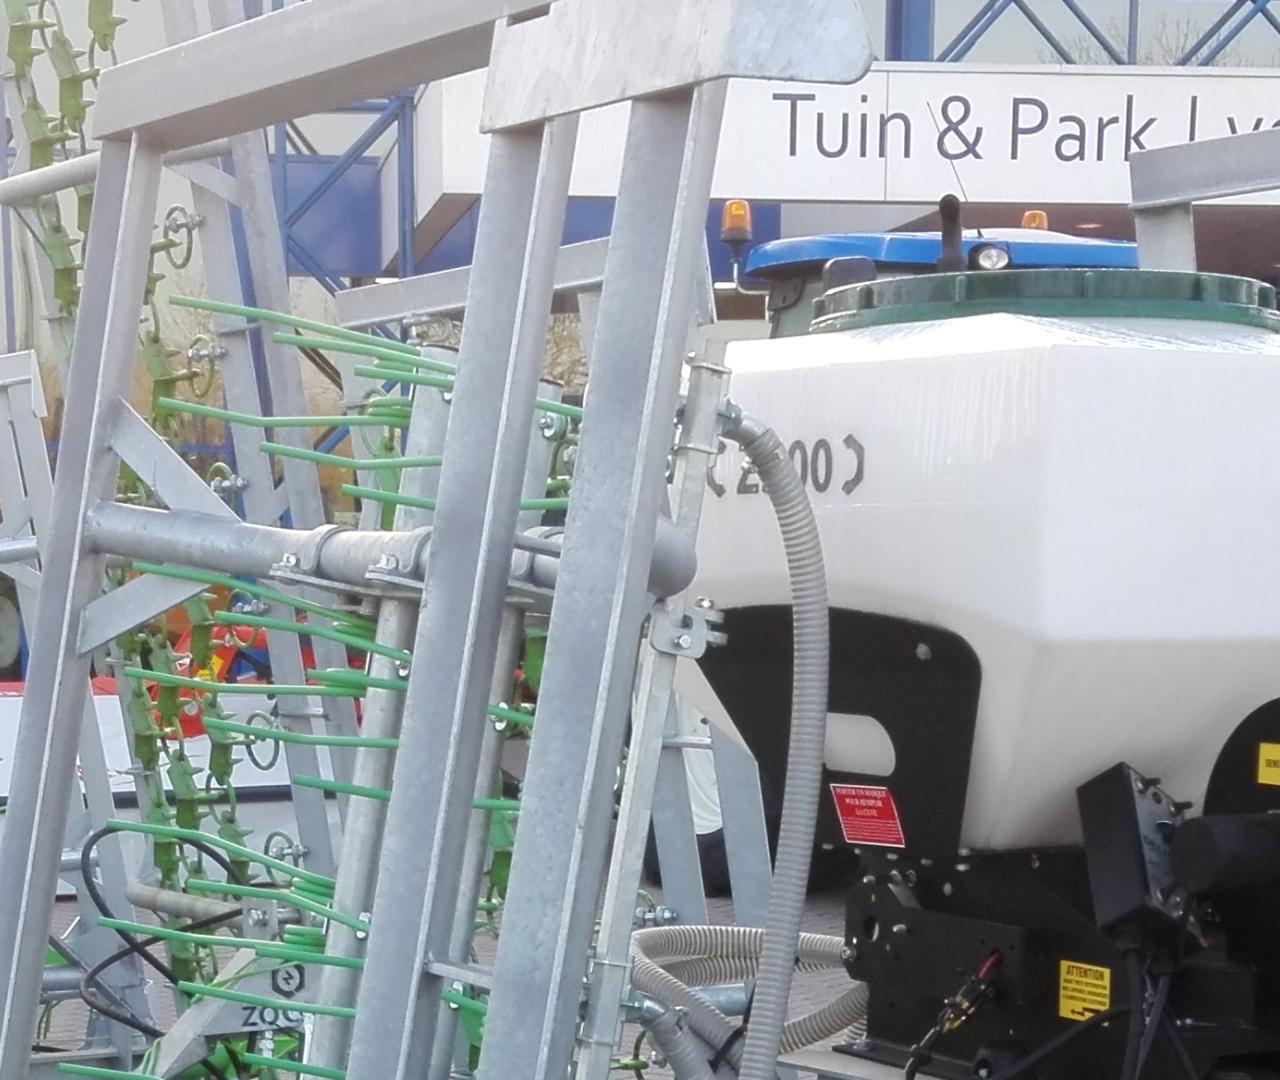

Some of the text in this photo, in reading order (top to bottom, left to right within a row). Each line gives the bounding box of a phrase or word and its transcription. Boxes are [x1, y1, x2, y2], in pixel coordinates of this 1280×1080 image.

[772, 91, 1159, 163] Tuin & Park
[1066, 965, 1105, 982] ATTENTION
[242, 1005, 304, 1028] ZOC
